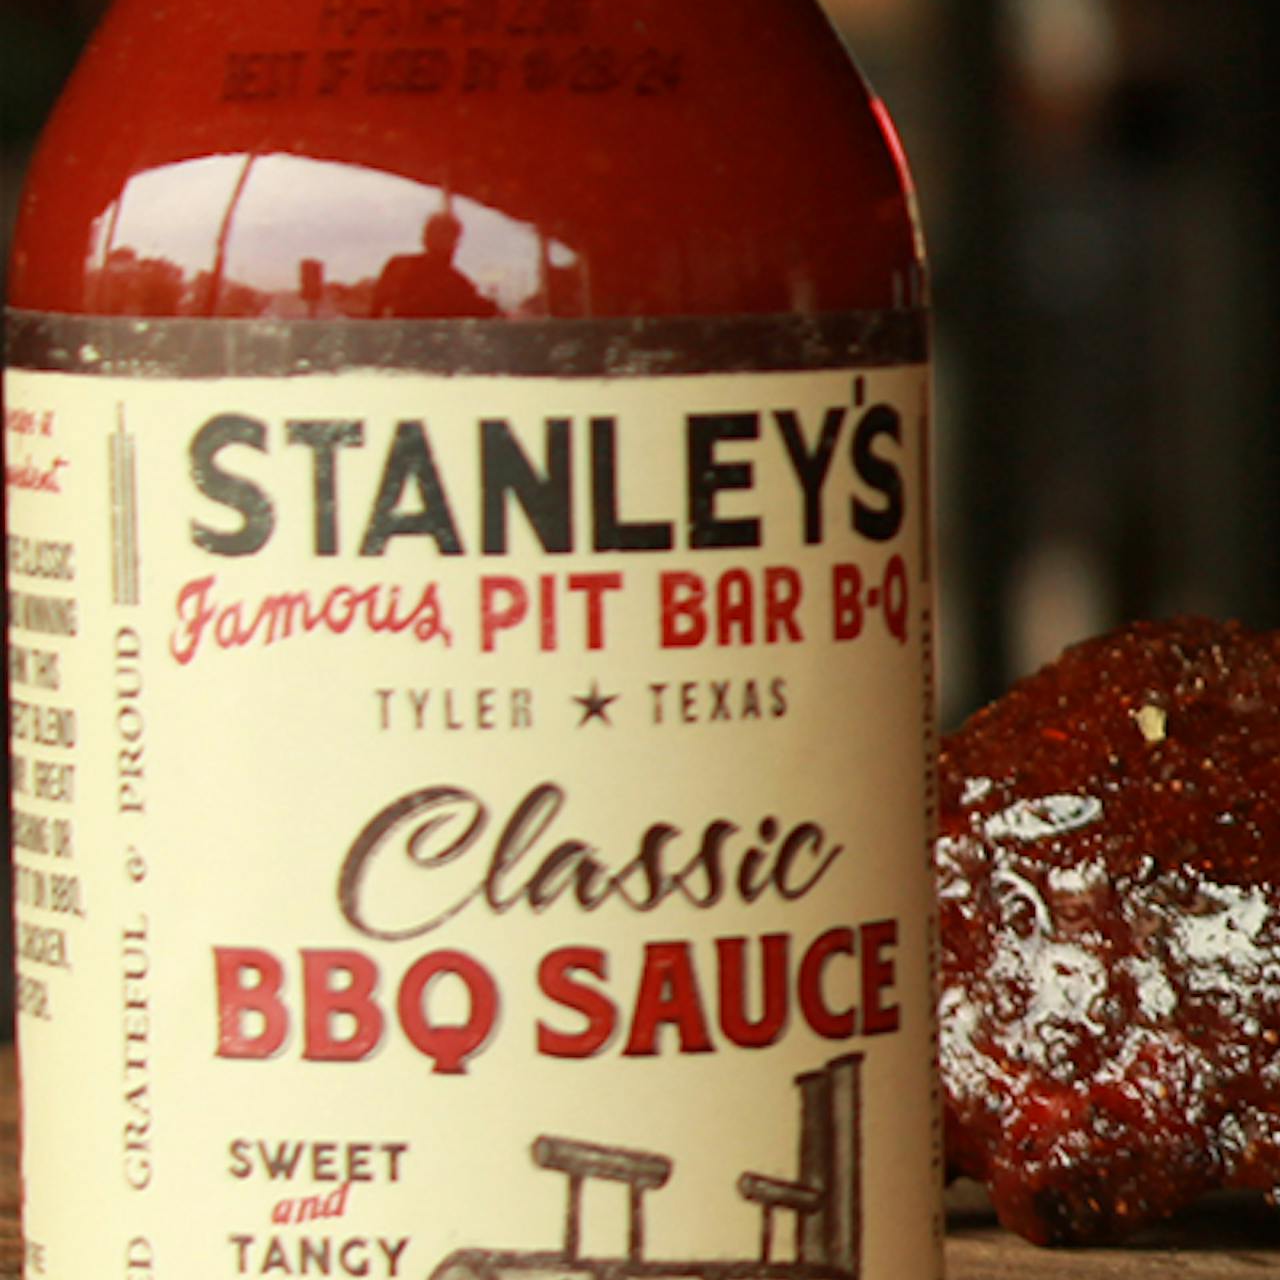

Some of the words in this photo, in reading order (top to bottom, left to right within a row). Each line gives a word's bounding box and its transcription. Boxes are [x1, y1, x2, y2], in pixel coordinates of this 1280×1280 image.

[189, 376, 906, 558] STANLEY'S
[168, 573, 452, 666] Famous
[480, 573, 623, 653] PIT
[658, 568, 806, 650] BAR
[117, 627, 143, 812] PROUD
[375, 688, 533, 731] TYLER
[649, 679, 789, 724] TEXAS
[337, 782, 843, 942] Classic
[123, 914, 153, 1191] GRATEFUL
[213, 945, 500, 1076] BBQ
[536, 920, 901, 1059] SAUCE
[229, 1140, 408, 1183] SWEET
[270, 1182, 349, 1226] and
[230, 1236, 412, 1277] TANGY
